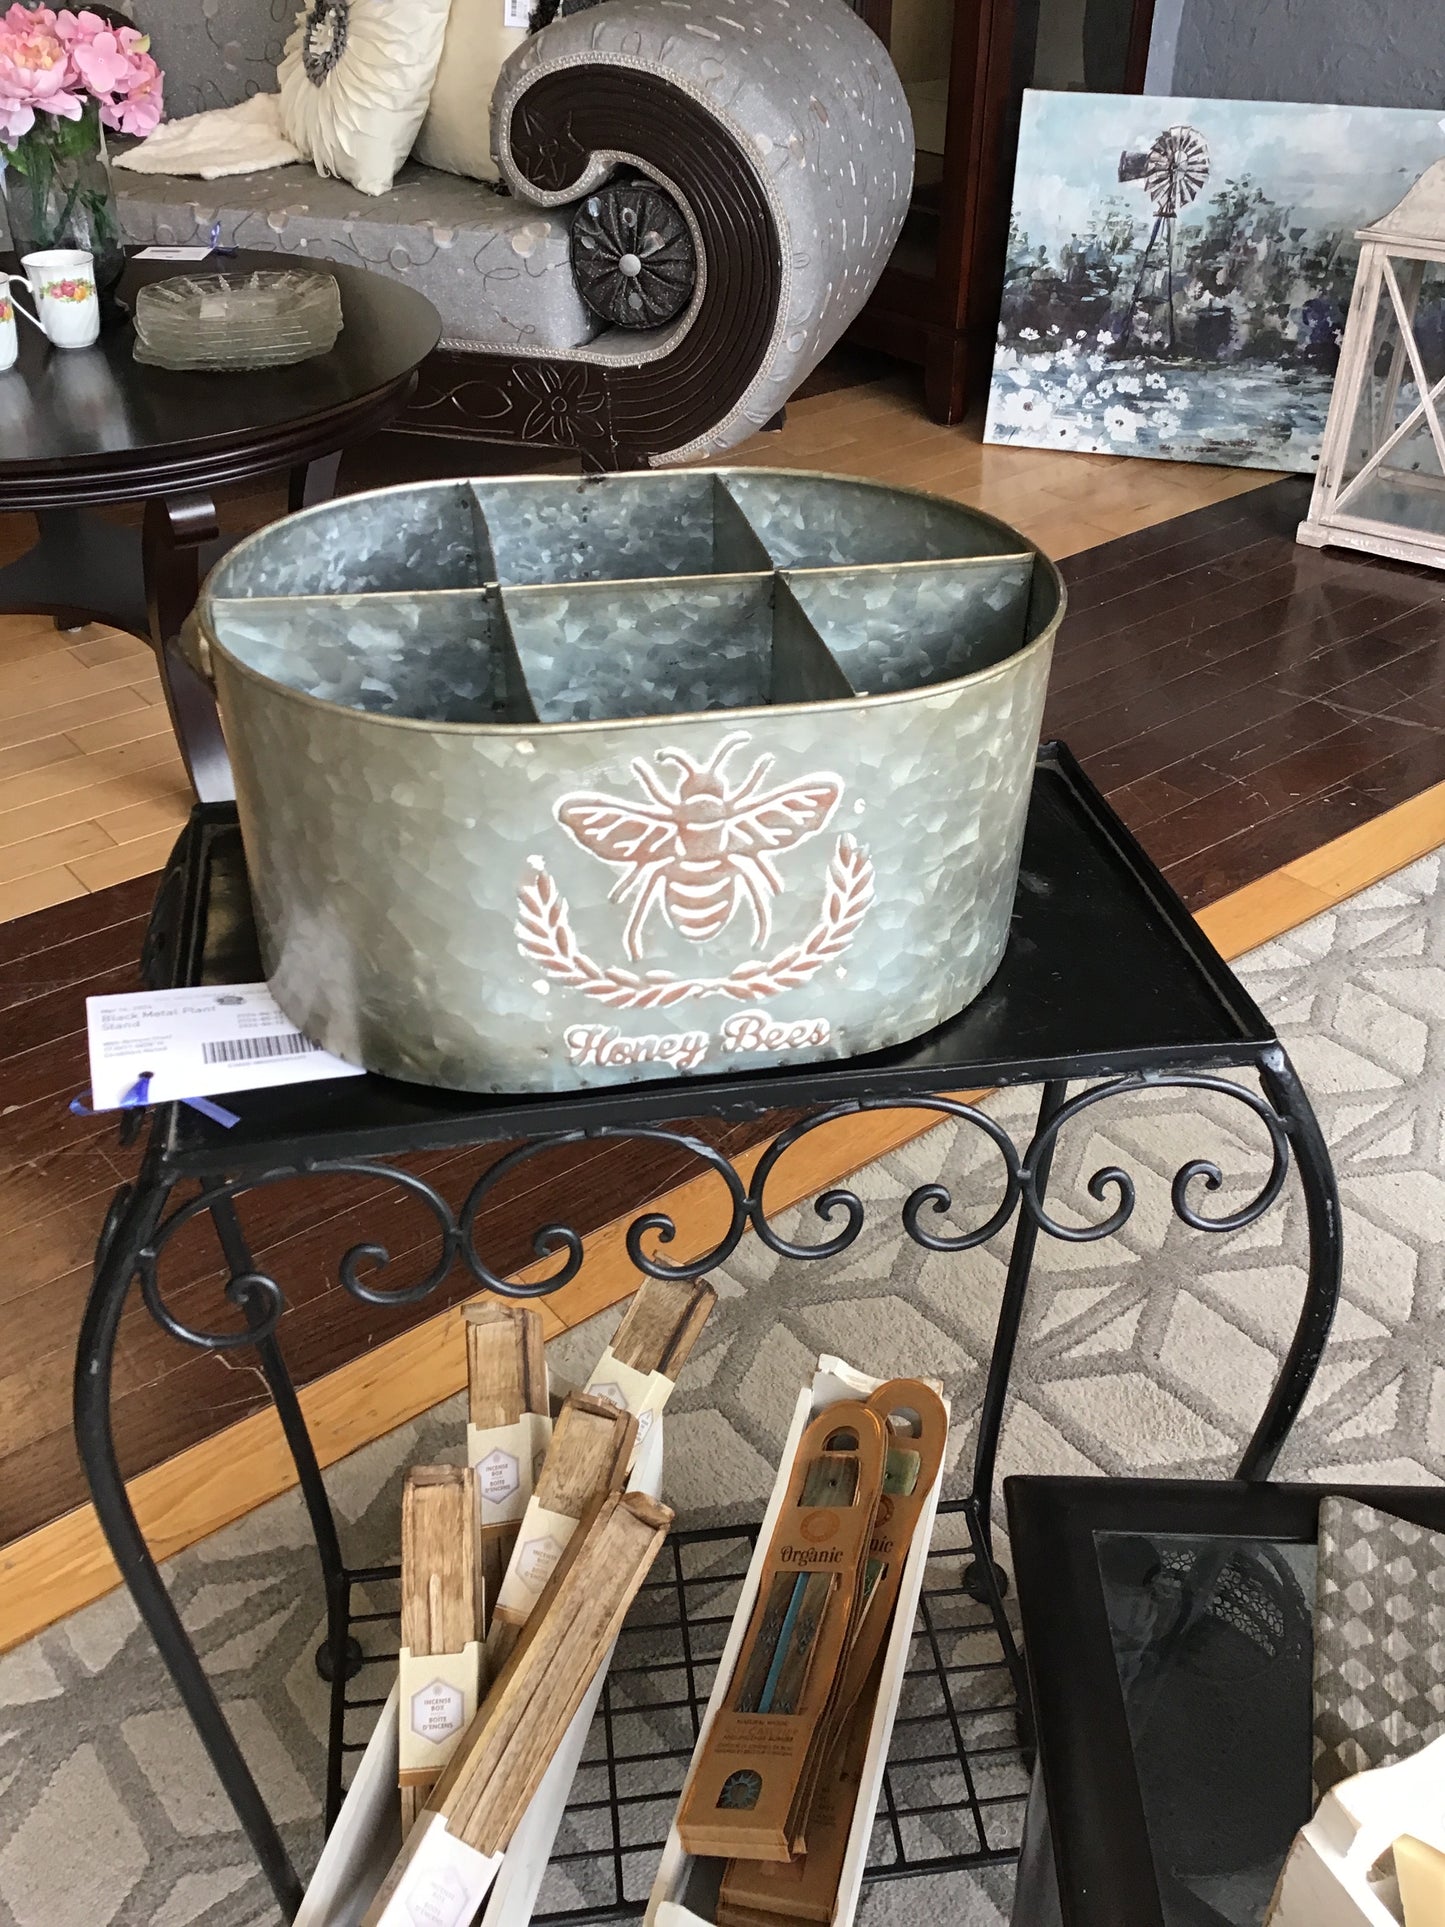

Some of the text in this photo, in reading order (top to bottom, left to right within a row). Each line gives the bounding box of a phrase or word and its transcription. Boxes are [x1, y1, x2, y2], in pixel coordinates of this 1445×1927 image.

[101, 1012, 139, 1023] Black
[142, 1008, 178, 1019] Metal
[182, 1005, 216, 1015] Plant
[101, 1021, 141, 1031] Stand
[565, 1010, 830, 1072] Honey Bees
[780, 1545, 844, 1567] Organic
[423, 1697, 452, 1705] INCENSE
